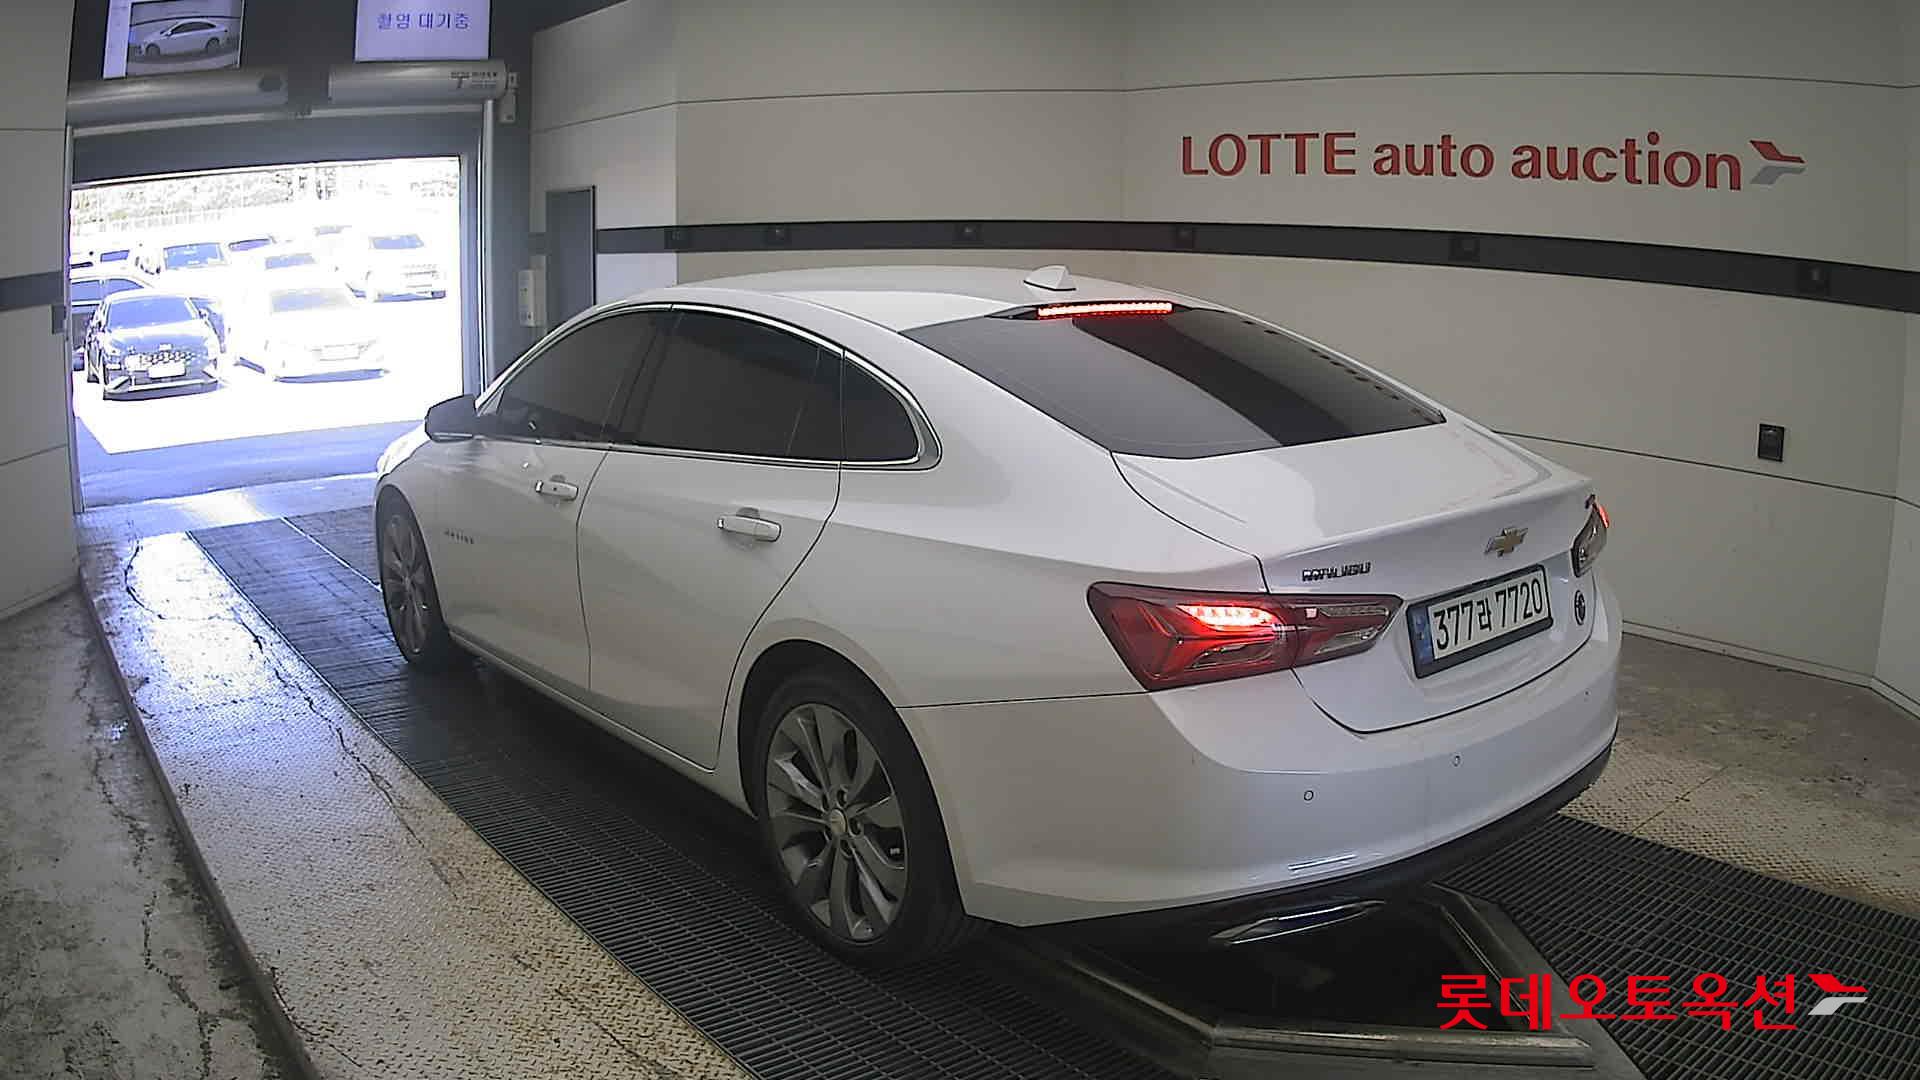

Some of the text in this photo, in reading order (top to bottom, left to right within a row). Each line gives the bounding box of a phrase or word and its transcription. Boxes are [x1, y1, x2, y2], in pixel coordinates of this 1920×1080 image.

[418, 12, 470, 30] 대기중
[1182, 131, 1742, 191] LOTTE auto auction
[1433, 578, 1544, 651] 377라 7720
